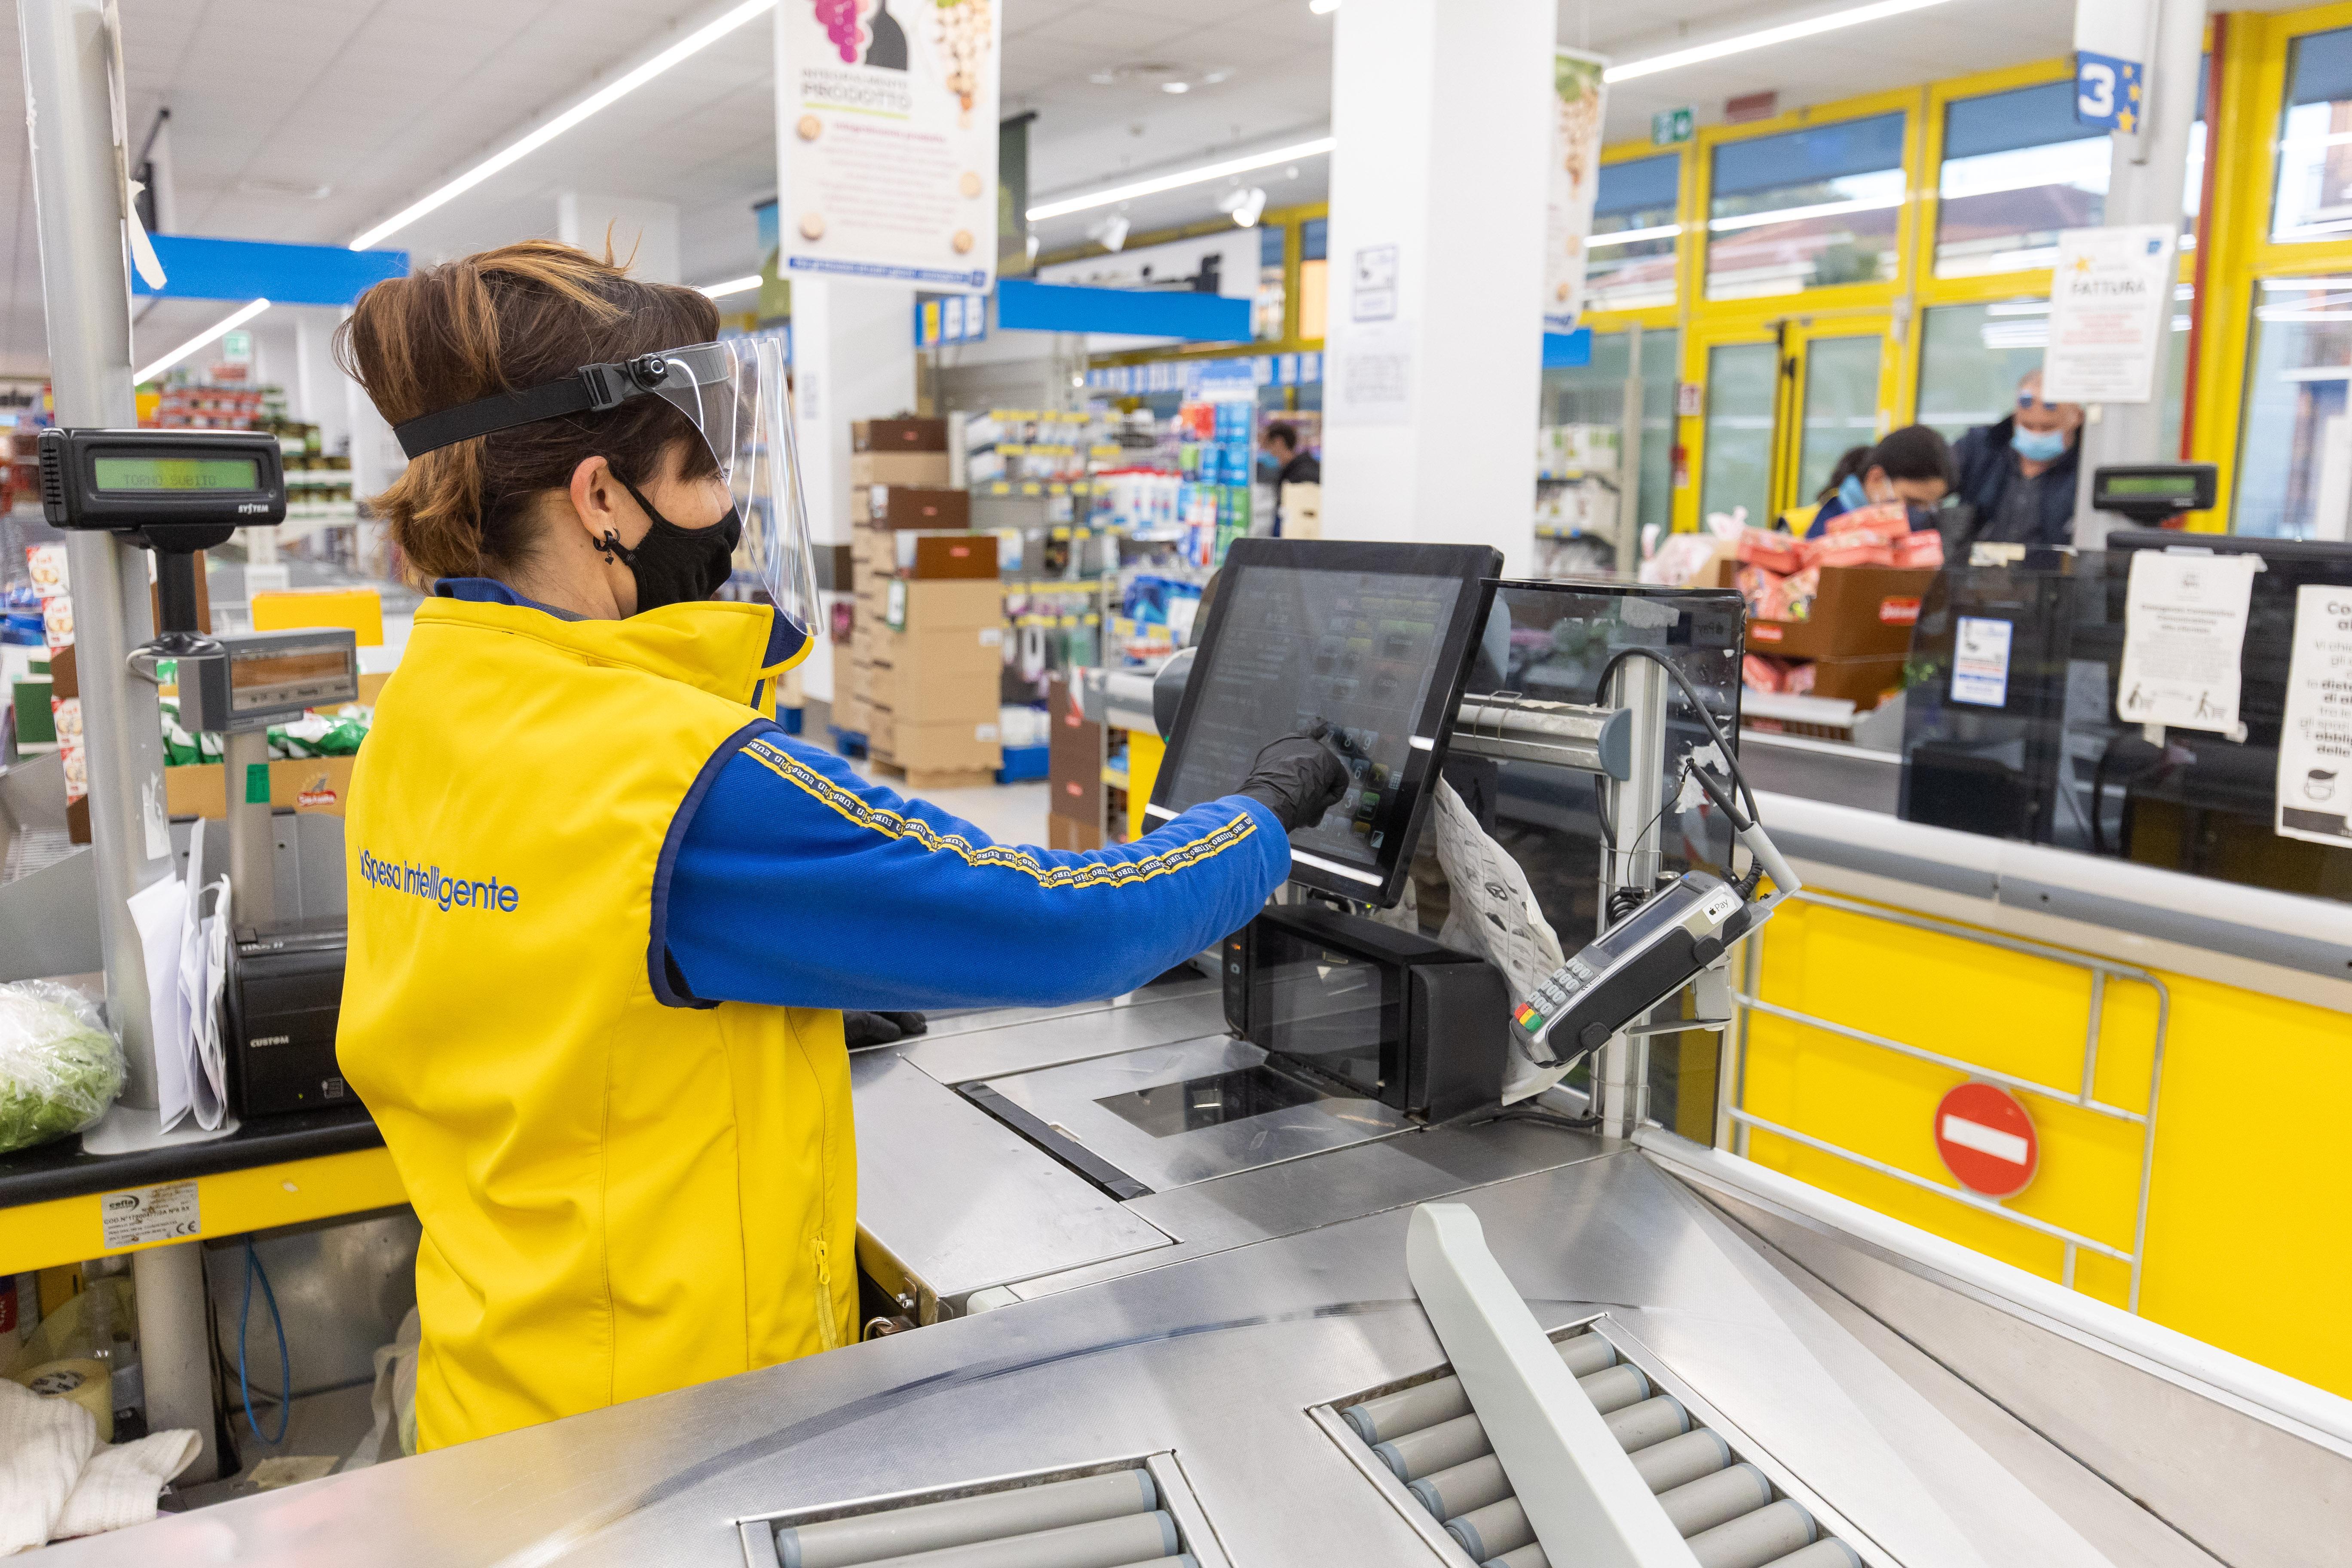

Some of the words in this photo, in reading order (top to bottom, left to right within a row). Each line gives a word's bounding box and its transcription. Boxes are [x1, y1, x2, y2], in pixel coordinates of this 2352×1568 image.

[2079, 63, 2116, 117] 3
[124, 474, 163, 486] TORNO
[2315, 731, 2352, 748] obbli
[774, 755, 815, 785] EUROSpin
[404, 860, 519, 912] intelligente
[1714, 899, 1728, 911] Pay
[250, 1035, 290, 1048] CUSTOM
